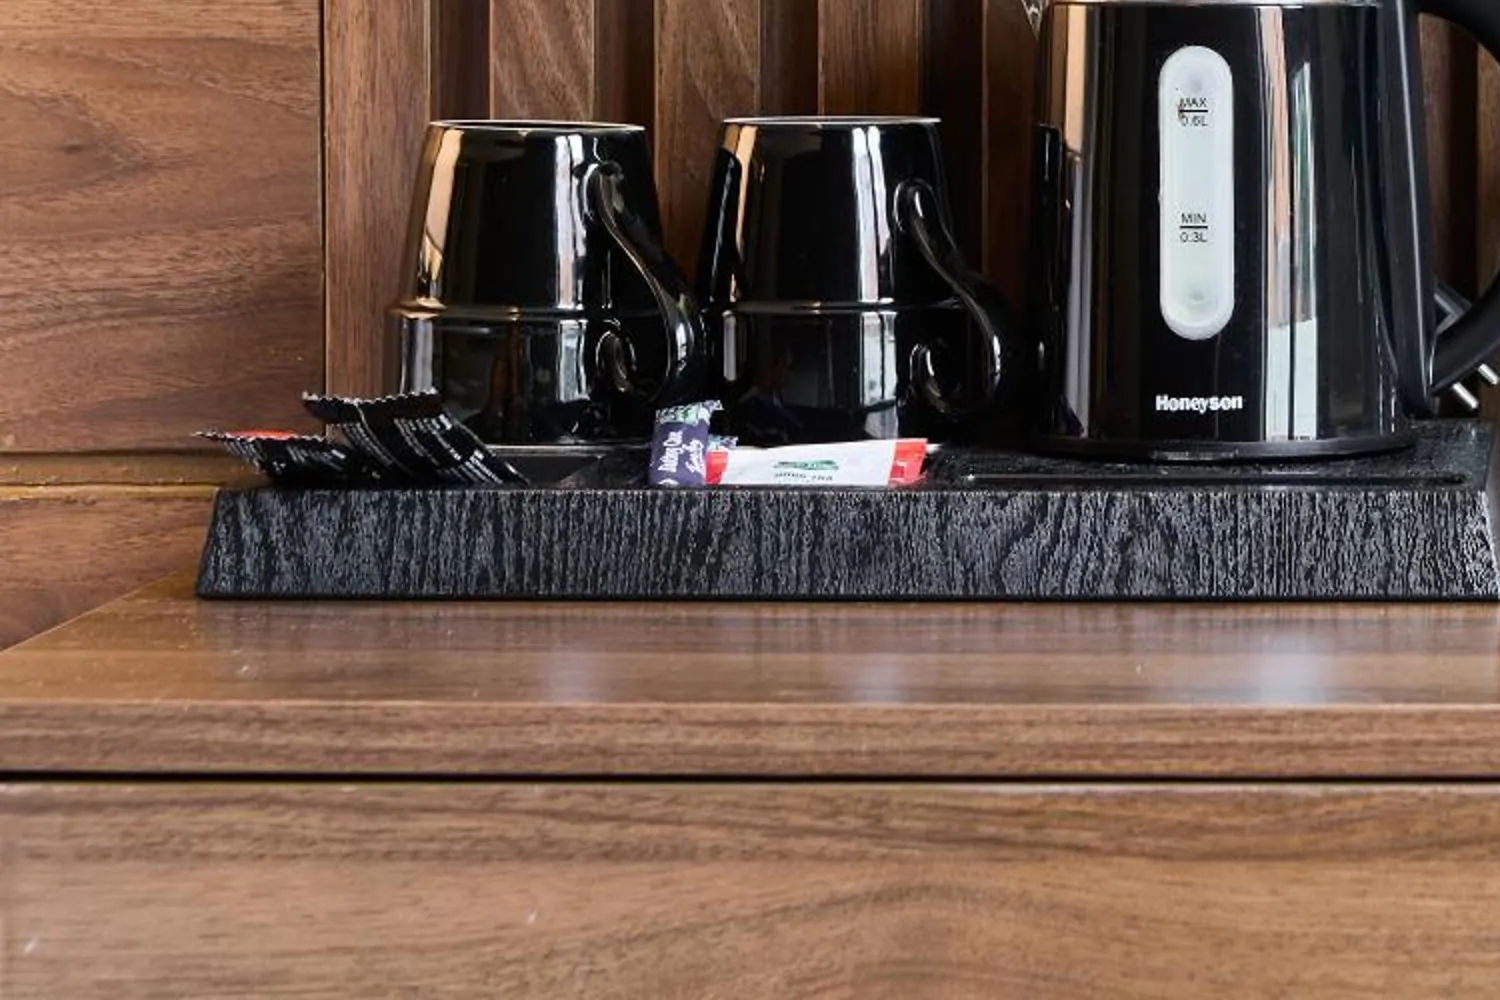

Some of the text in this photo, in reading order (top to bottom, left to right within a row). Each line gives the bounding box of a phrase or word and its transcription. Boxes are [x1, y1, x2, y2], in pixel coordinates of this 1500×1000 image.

[1179, 97, 1207, 108] MAX
[1180, 115, 1208, 126] 0.6L
[1181, 213, 1207, 223] MIN
[1179, 231, 1208, 243] 0.3L
[1155, 394, 1243, 414] Honeyson
